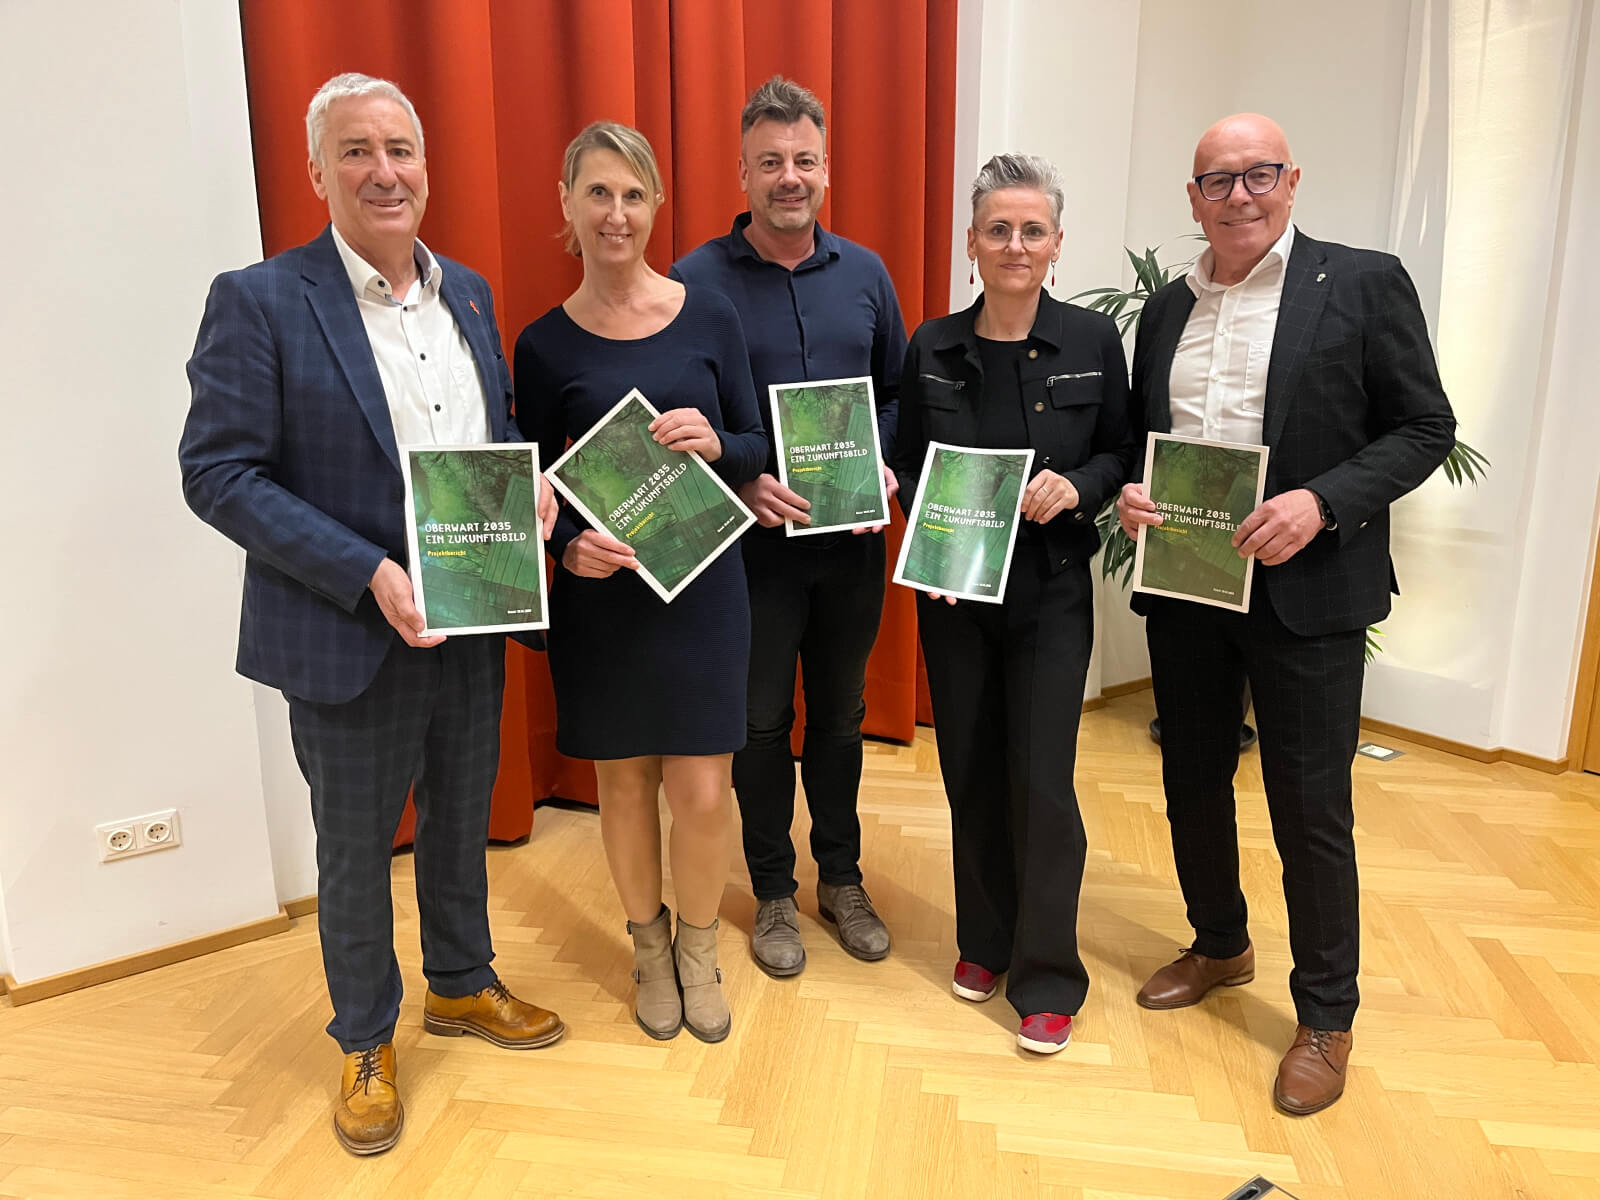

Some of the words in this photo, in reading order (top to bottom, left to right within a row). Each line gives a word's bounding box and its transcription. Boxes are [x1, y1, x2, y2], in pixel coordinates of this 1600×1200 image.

[789, 443, 831, 454] OBERWART
[833, 440, 856, 450] 2035
[790, 455, 805, 463] EIN
[807, 448, 868, 462] ZUKUNFTSBILD
[608, 482, 649, 522] OBERWART
[648, 463, 671, 486] 2035
[615, 517, 633, 531] EIN
[630, 462, 687, 516] ZUKUNFTSBILD
[927, 502, 973, 517] OBERWART
[974, 510, 996, 519] 2035
[1155, 511, 1171, 521] IN
[1156, 502, 1204, 517] OBERWART
[1206, 509, 1231, 520] 2035
[424, 522, 480, 533] OBERWART
[483, 521, 512, 531] 2035
[925, 511, 941, 521] EIN
[943, 514, 1006, 528] ZUKUNFTSBILD
[425, 534, 445, 544] EIN
[447, 532, 527, 544] ZUKUNFTSBILD
